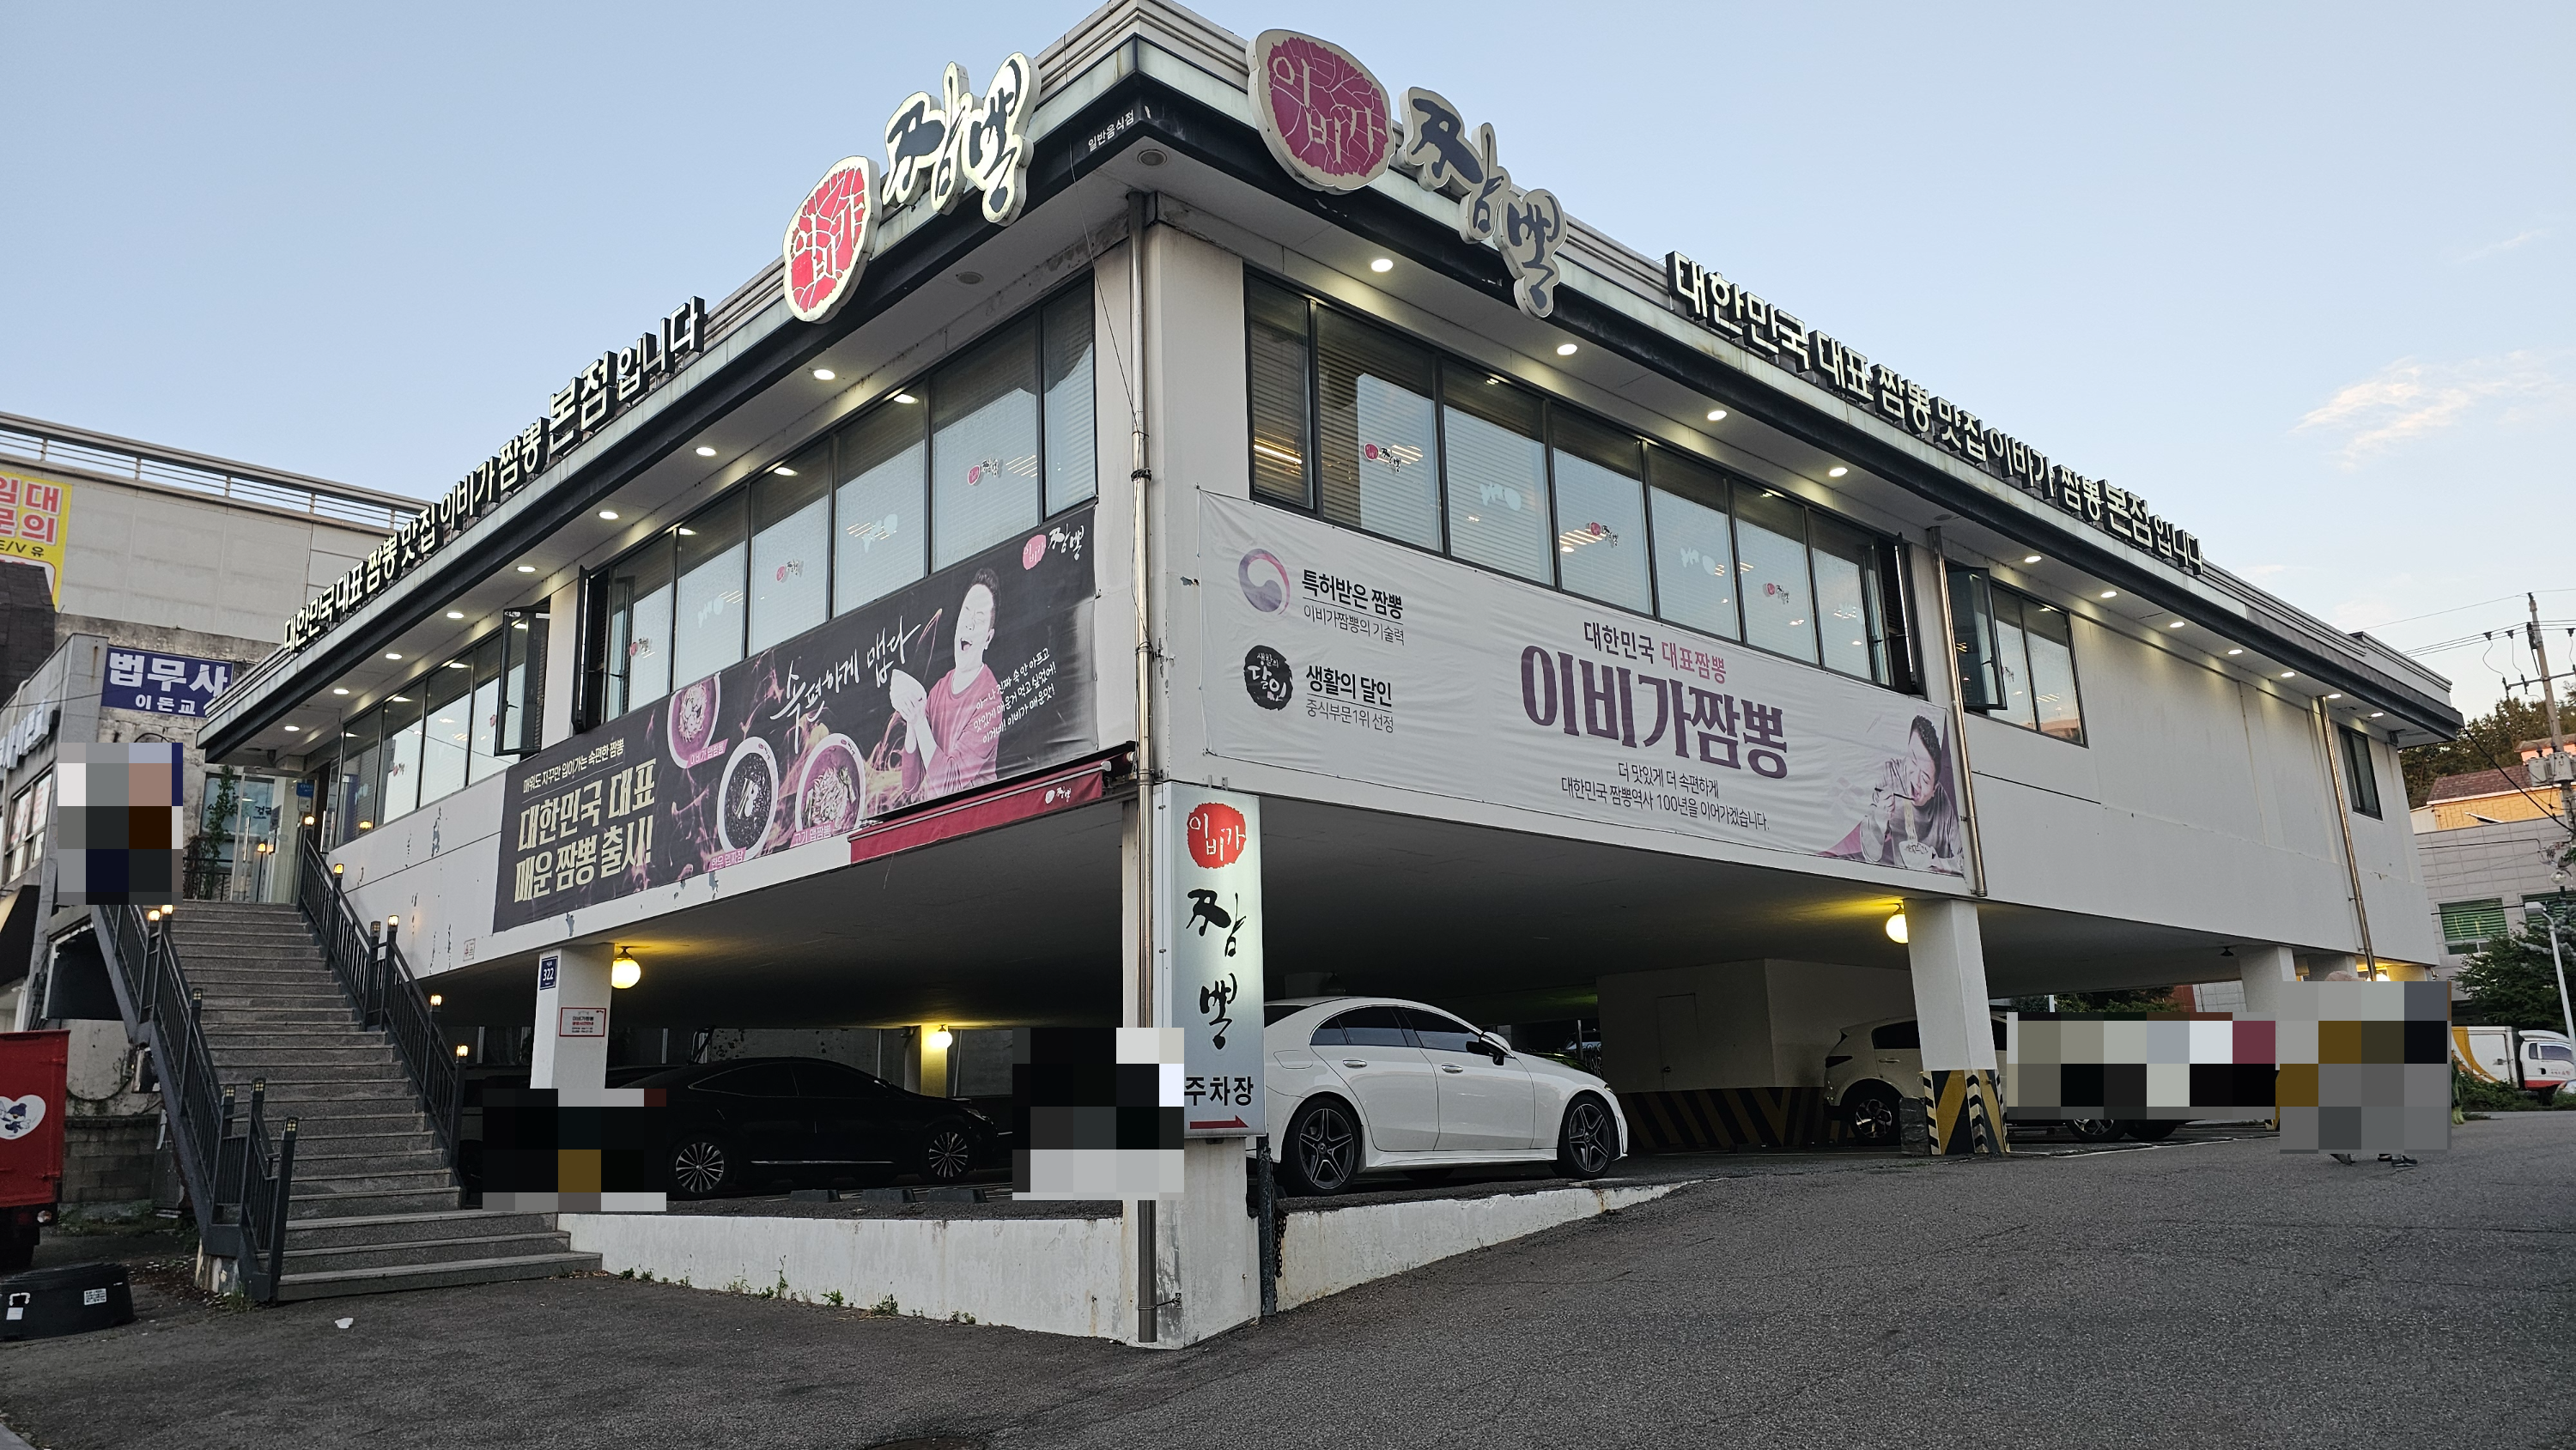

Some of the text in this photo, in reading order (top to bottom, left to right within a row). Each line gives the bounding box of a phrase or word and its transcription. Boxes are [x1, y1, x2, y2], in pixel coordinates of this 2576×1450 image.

[1088, 108, 1134, 153] 일반음식점
[1273, 57, 1385, 164] 이비가
[790, 191, 866, 282] 이비가
[1674, 251, 1810, 371] 대한민국
[1816, 331, 1874, 403] 대표
[1878, 364, 1931, 433] 짬뽕
[1938, 397, 1987, 462] 맛집
[1989, 428, 2056, 498] 이비가
[2060, 464, 2104, 521] 짬뽕
[31, 546, 45, 558] 유
[284, 584, 337, 652] 대한민국
[336, 561, 365, 613] 대표
[367, 531, 398, 594] 짬뽕
[401, 503, 436, 567] 맛집
[440, 456, 495, 530] 이비가
[499, 417, 542, 491] 짬뽕
[1024, 541, 1046, 562] 이비가
[1302, 569, 1403, 620] 특허받은 짬뽕
[1304, 605, 1404, 646] 이비가짬뽕의 기술력
[109, 652, 228, 697] 법무사
[996, 676, 1012, 695] 진짜
[1030, 647, 1050, 669] 아프고
[1583, 622, 1727, 684] 대한민국 대표짬뽕
[769, 616, 921, 754] 속편하게 맵다
[1248, 665, 1287, 701] 달인
[1306, 665, 1392, 707] 생활의 달인
[974, 708, 996, 733] 맛있게
[1007, 703, 1030, 725] 이비가
[1372, 713, 1394, 733] 선정
[1521, 645, 1788, 779] 이비가짬뽕
[523, 774, 542, 793] 매워도
[542, 767, 561, 786] 자꾸만
[588, 745, 609, 765] 속편한
[610, 737, 624, 758] 짬뽕
[1619, 761, 1719, 799] 더 맛있게 더 속편하게
[518, 758, 657, 852] 대한민국 대표
[1561, 777, 1770, 831] 대한민국 짬뽕역사 100년을 이어가겠습니다.
[514, 815, 653, 902] 매운 짬뽕 출시!
[1188, 812, 1246, 861] 이비가
[542, 967, 554, 981] 322
[1184, 1075, 1254, 1107] 주차장
